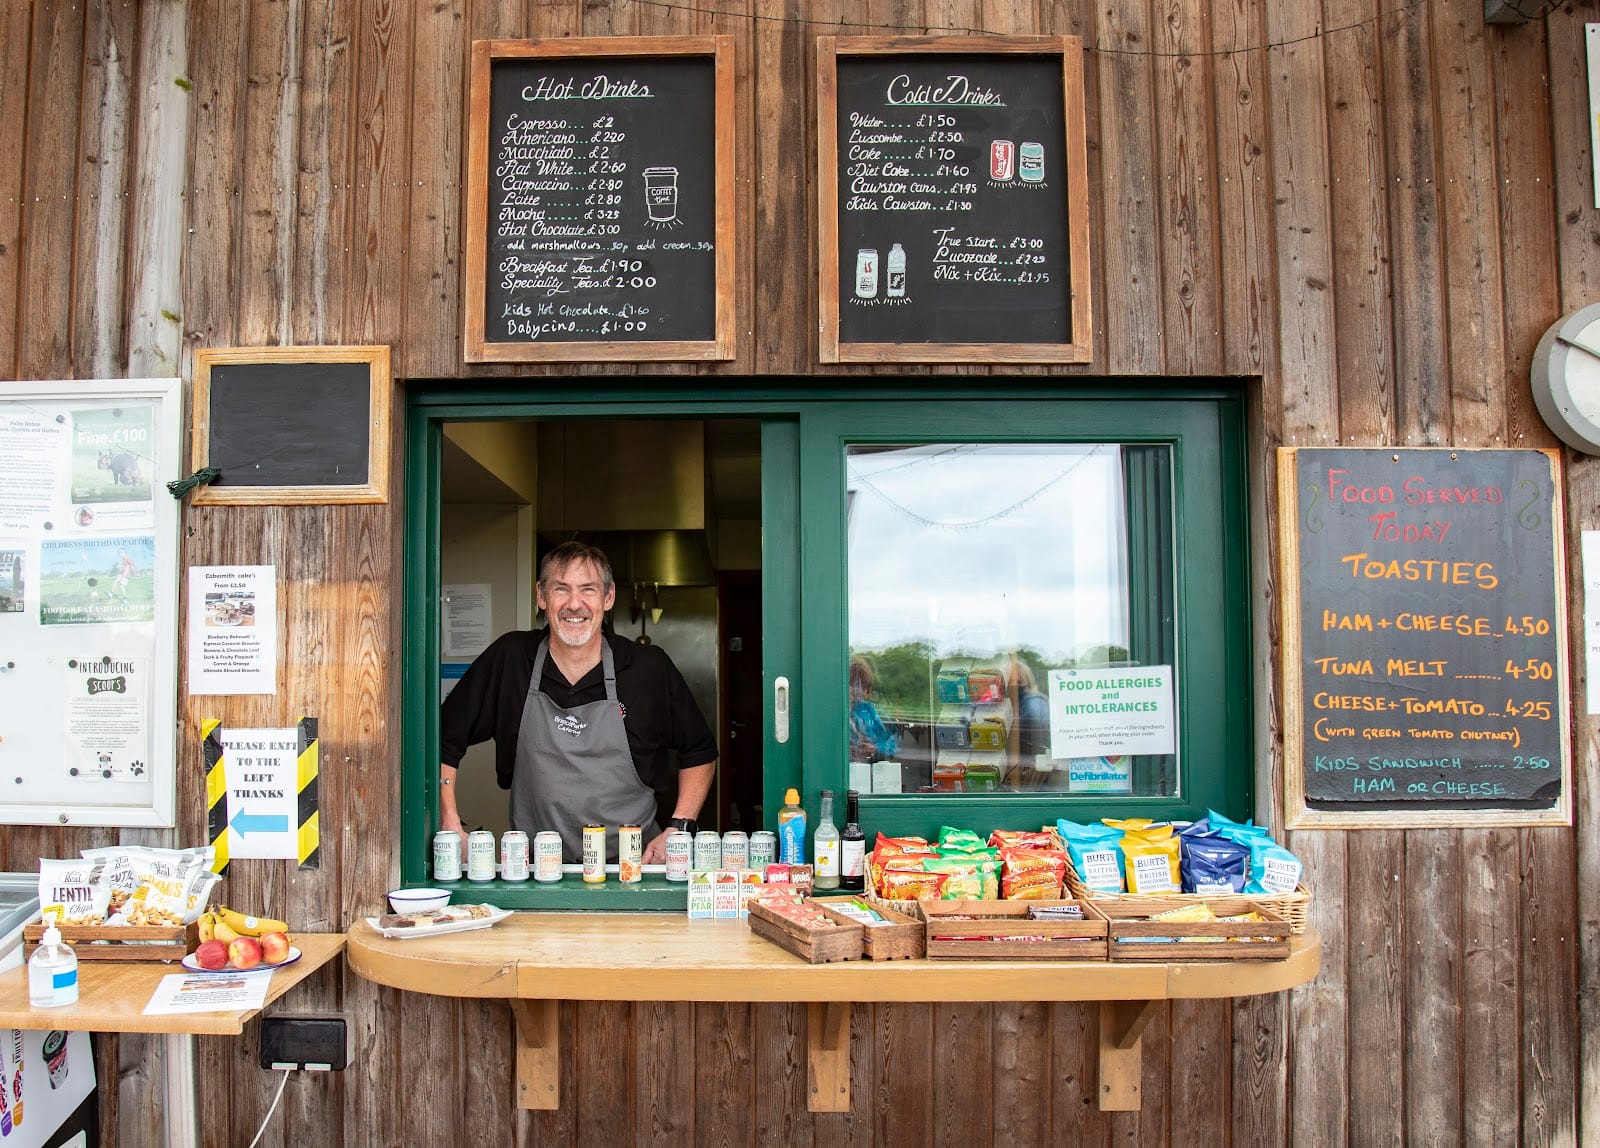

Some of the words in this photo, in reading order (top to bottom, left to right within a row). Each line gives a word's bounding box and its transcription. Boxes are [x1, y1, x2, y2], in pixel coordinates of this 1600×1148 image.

[522, 76, 573, 100] Hot
[581, 75, 649, 100] Drinks
[887, 75, 931, 104] Cold
[593, 117, 613, 128] £2
[589, 146, 609, 159] £2
[497, 160, 530, 176] Flat
[847, 163, 880, 177] Diet
[852, 177, 906, 194] Cawston
[846, 196, 877, 211] Kids
[498, 222, 526, 236] Hot
[933, 227, 961, 246] True
[507, 242, 524, 250] add
[637, 242, 655, 250] add
[499, 257, 567, 276] Breakfast
[934, 265, 960, 280] Nix
[501, 274, 569, 296] Speciality
[538, 303, 553, 315] Hot
[1341, 553, 1499, 590] TOASTIES
[1323, 610, 1372, 631] HAM
[80, 662, 134, 674] INTRODUCING
[1314, 657, 1374, 676] TUNA
[1388, 659, 1448, 677] MELT
[1060, 681, 1093, 691] FOOD
[1096, 678, 1162, 689] ALLERGIES
[1102, 692, 1119, 700] and
[1066, 702, 1157, 715] INTOLERANCES
[1363, 728, 1401, 738] GREEN
[1408, 729, 1454, 738] TOMATO
[222, 742, 266, 750] PLEASE
[270, 742, 297, 750] EXIT
[237, 758, 252, 766] TO
[256, 758, 280, 766] THE
[1071, 761, 1094, 770] have
[1369, 757, 1461, 769] SANDWICH
[244, 774, 274, 782] LEFT
[1071, 772, 1128, 780] Defibrillator
[1354, 778, 1395, 794] HAM
[234, 790, 284, 798] THANKS
[1086, 853, 1114, 863] BURTS
[1138, 857, 1166, 867] BURTS
[1268, 861, 1296, 872] BURTS
[64, 874, 81, 883] Real
[53, 887, 93, 903] LENTIL
[70, 905, 93, 915] Chips
